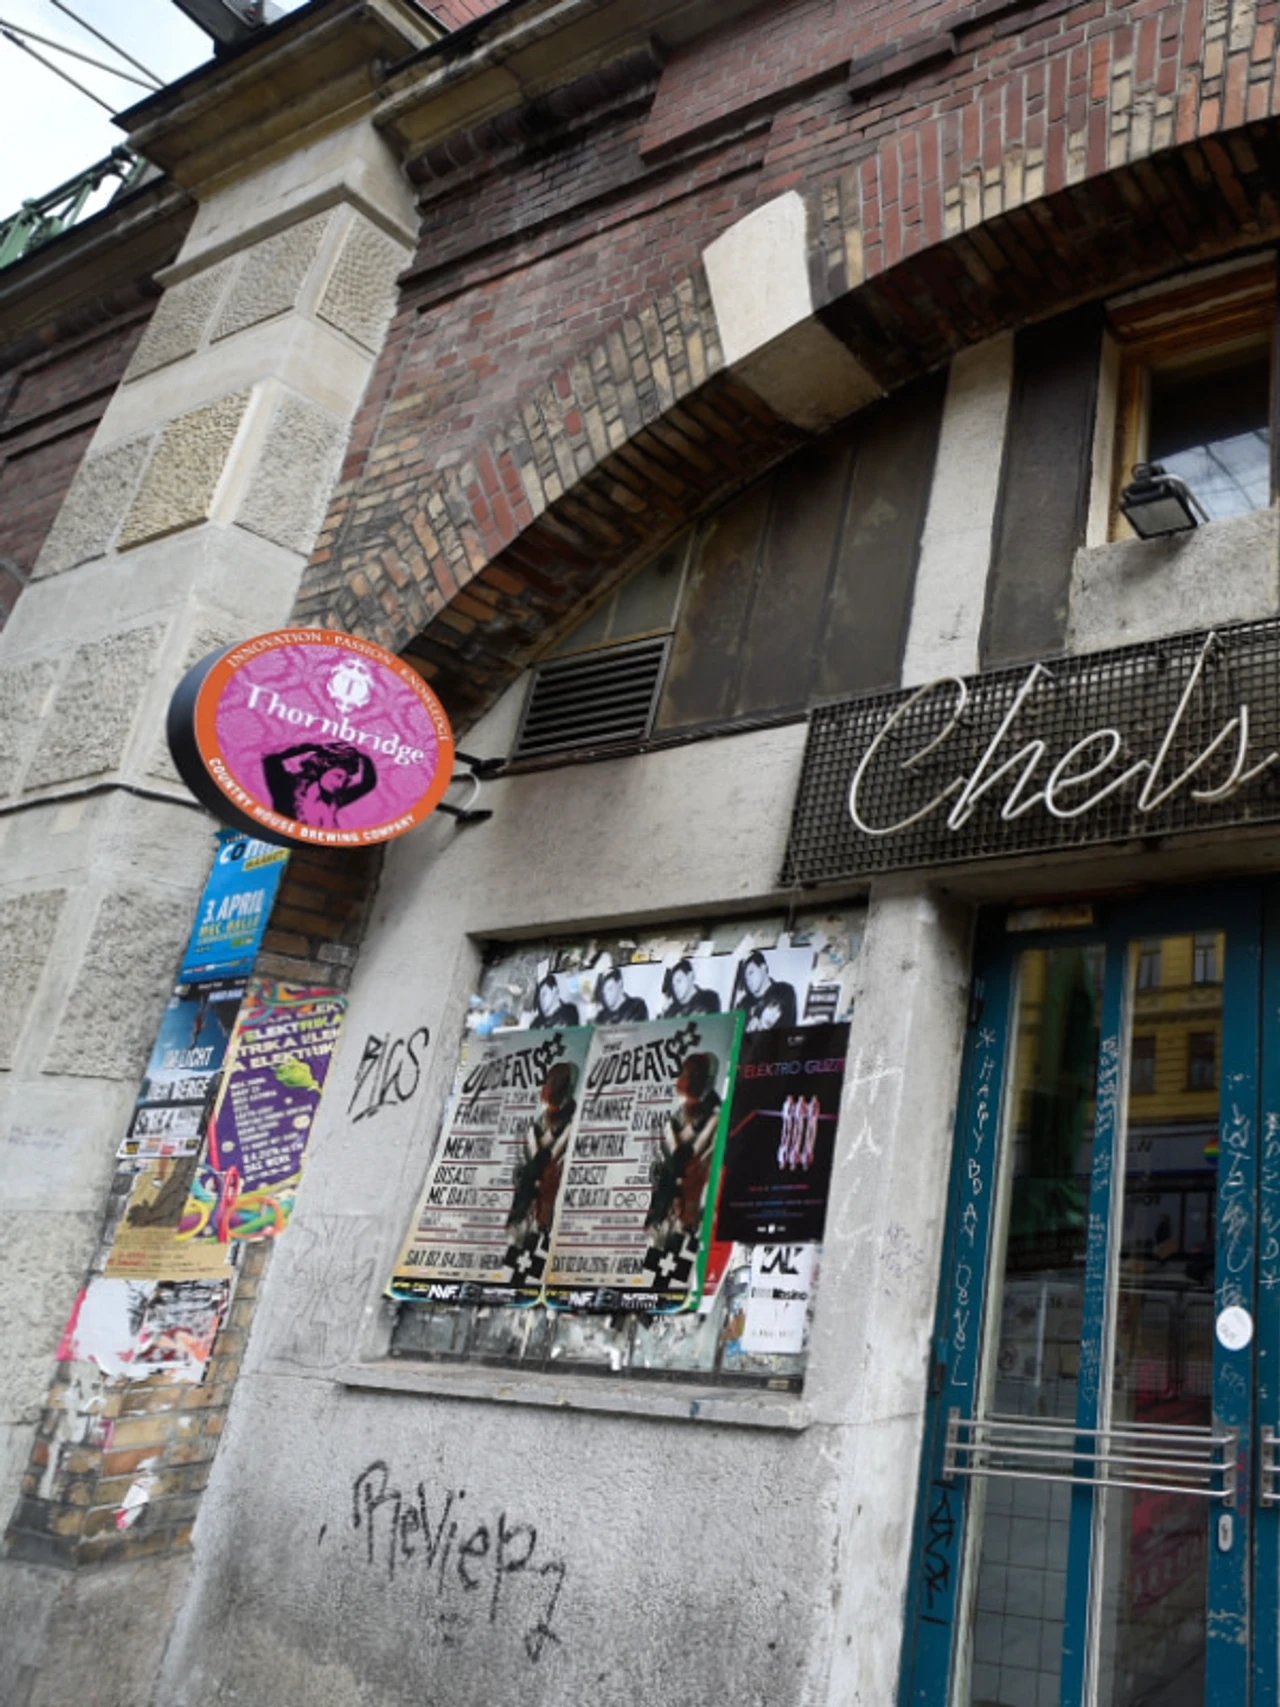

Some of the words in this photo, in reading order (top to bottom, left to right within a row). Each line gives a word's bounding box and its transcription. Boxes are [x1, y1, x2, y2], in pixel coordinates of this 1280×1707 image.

[228, 631, 322, 668] INNOVATION
[335, 635, 392, 666] PASSION
[400, 668, 449, 742] KNOWLEDGE
[246, 684, 424, 766] Thornbridge
[209, 757, 253, 808] COUNTRY
[254, 806, 294, 834] HOUSE
[300, 829, 359, 843] BREWING
[363, 815, 415, 842] COMPANY
